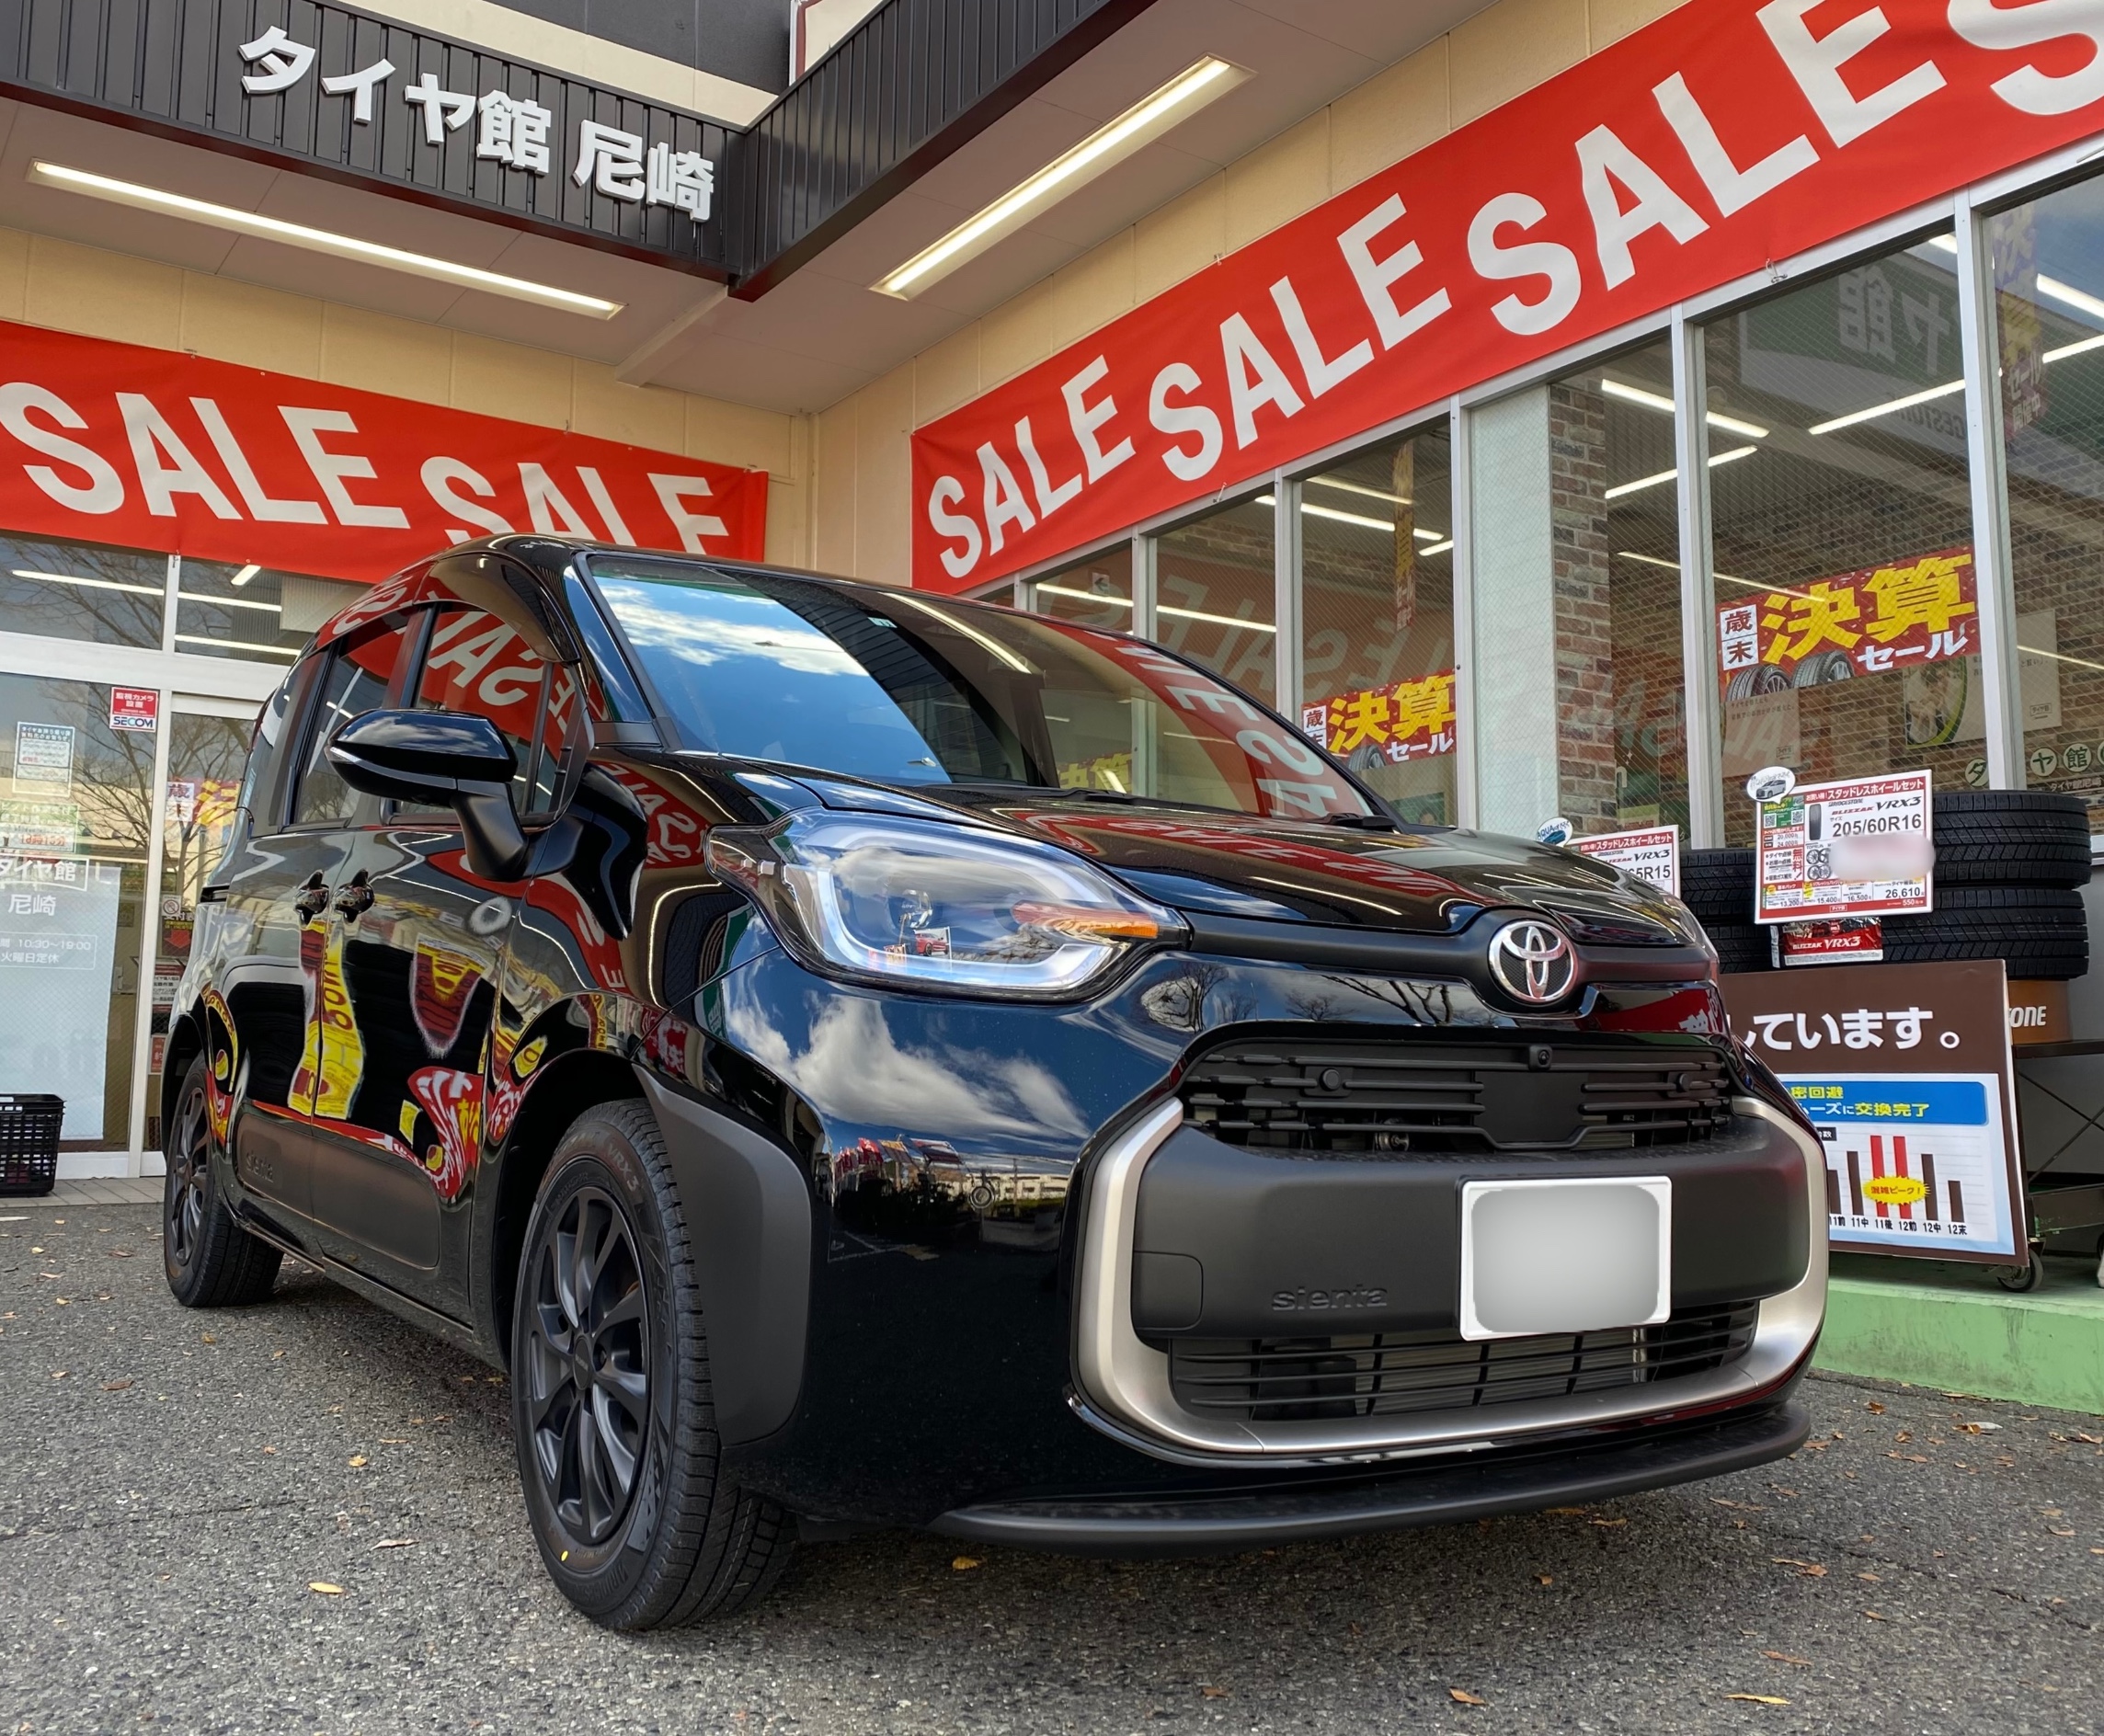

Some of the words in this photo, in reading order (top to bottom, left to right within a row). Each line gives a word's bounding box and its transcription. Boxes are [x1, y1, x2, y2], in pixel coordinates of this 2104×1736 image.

[238, 25, 552, 176] タイヤ館
[574, 119, 715, 223] 尼崎
[928, 354, 1137, 578] SALE
[1149, 193, 1453, 481] SALE
[1467, 0, 1948, 337] SALE
[0, 382, 411, 530] SALE
[1760, 554, 1976, 665] 決算
[1724, 610, 1754, 666] 歳末
[1857, 630, 1970, 672] セール
[115, 691, 154, 702] 監視カメラ
[113, 715, 154, 728] SECOM
[1328, 674, 1456, 754] 決算
[1387, 733, 1455, 762] セール
[1827, 779, 1924, 800] スタッドレスホイールセット
[1831, 806, 1874, 816] BLIZZAK
[1875, 795, 1922, 811] VRX3
[1832, 813, 1922, 838] 205/60R16
[1634, 849, 1671, 862] VRX3
[0, 859, 76, 882] タイヤ館
[7, 893, 56, 916] 尼崎
[1792, 942, 1823, 950] BLIZZAK
[1824, 935, 1861, 949] VRX3
[1, 952, 60, 964] 火曜日定休
[1851, 1217, 1869, 1228] 11中
[1875, 1219, 1893, 1230] 11後
[1898, 1220, 1917, 1232] 12前
[1923, 1223, 1941, 1233] 12中
[1948, 1224, 1968, 1236] 12末
[1272, 1284, 1388, 1310] sienta
